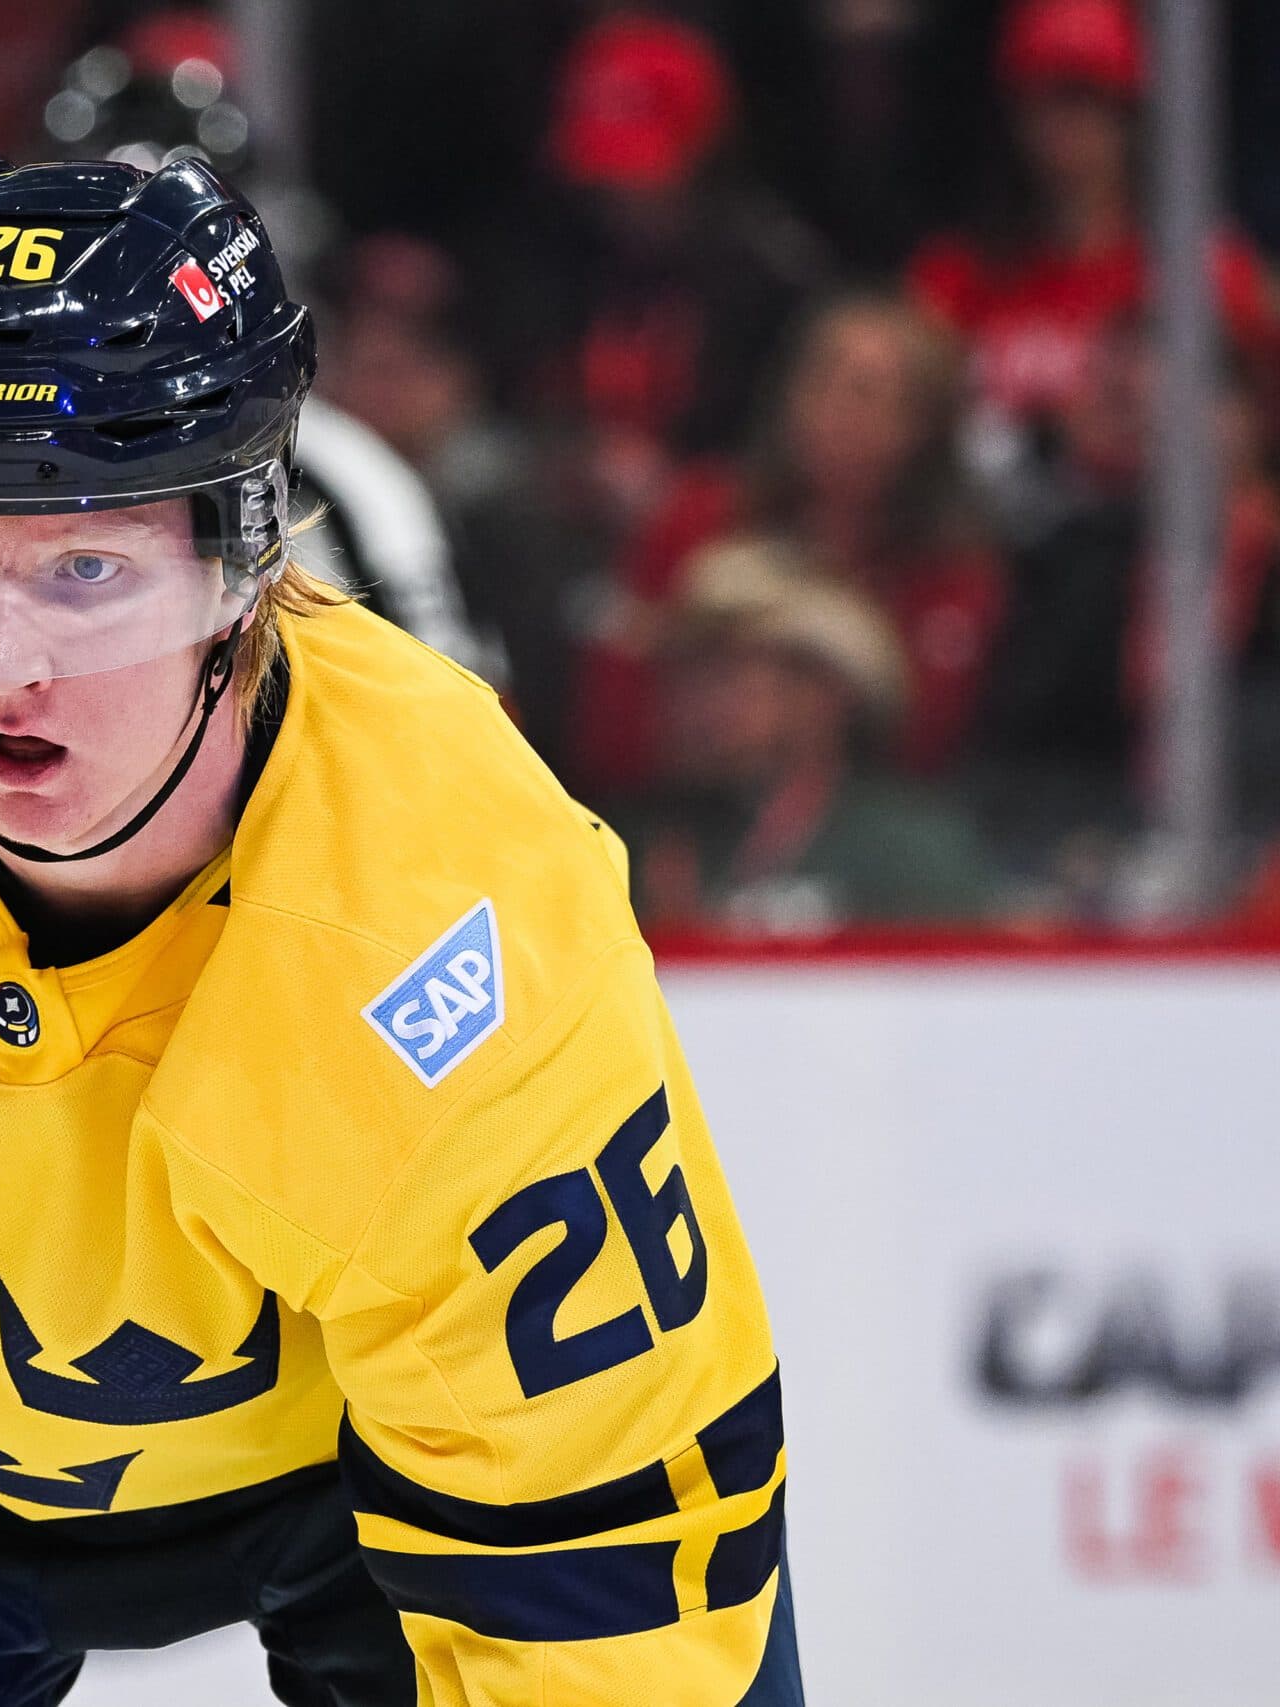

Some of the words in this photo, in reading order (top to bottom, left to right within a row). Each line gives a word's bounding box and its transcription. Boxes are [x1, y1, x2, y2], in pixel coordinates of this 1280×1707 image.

[207, 227, 260, 282] SVENSKA
[391, 949, 492, 1060] SAP
[468, 1080, 708, 1400] 26
